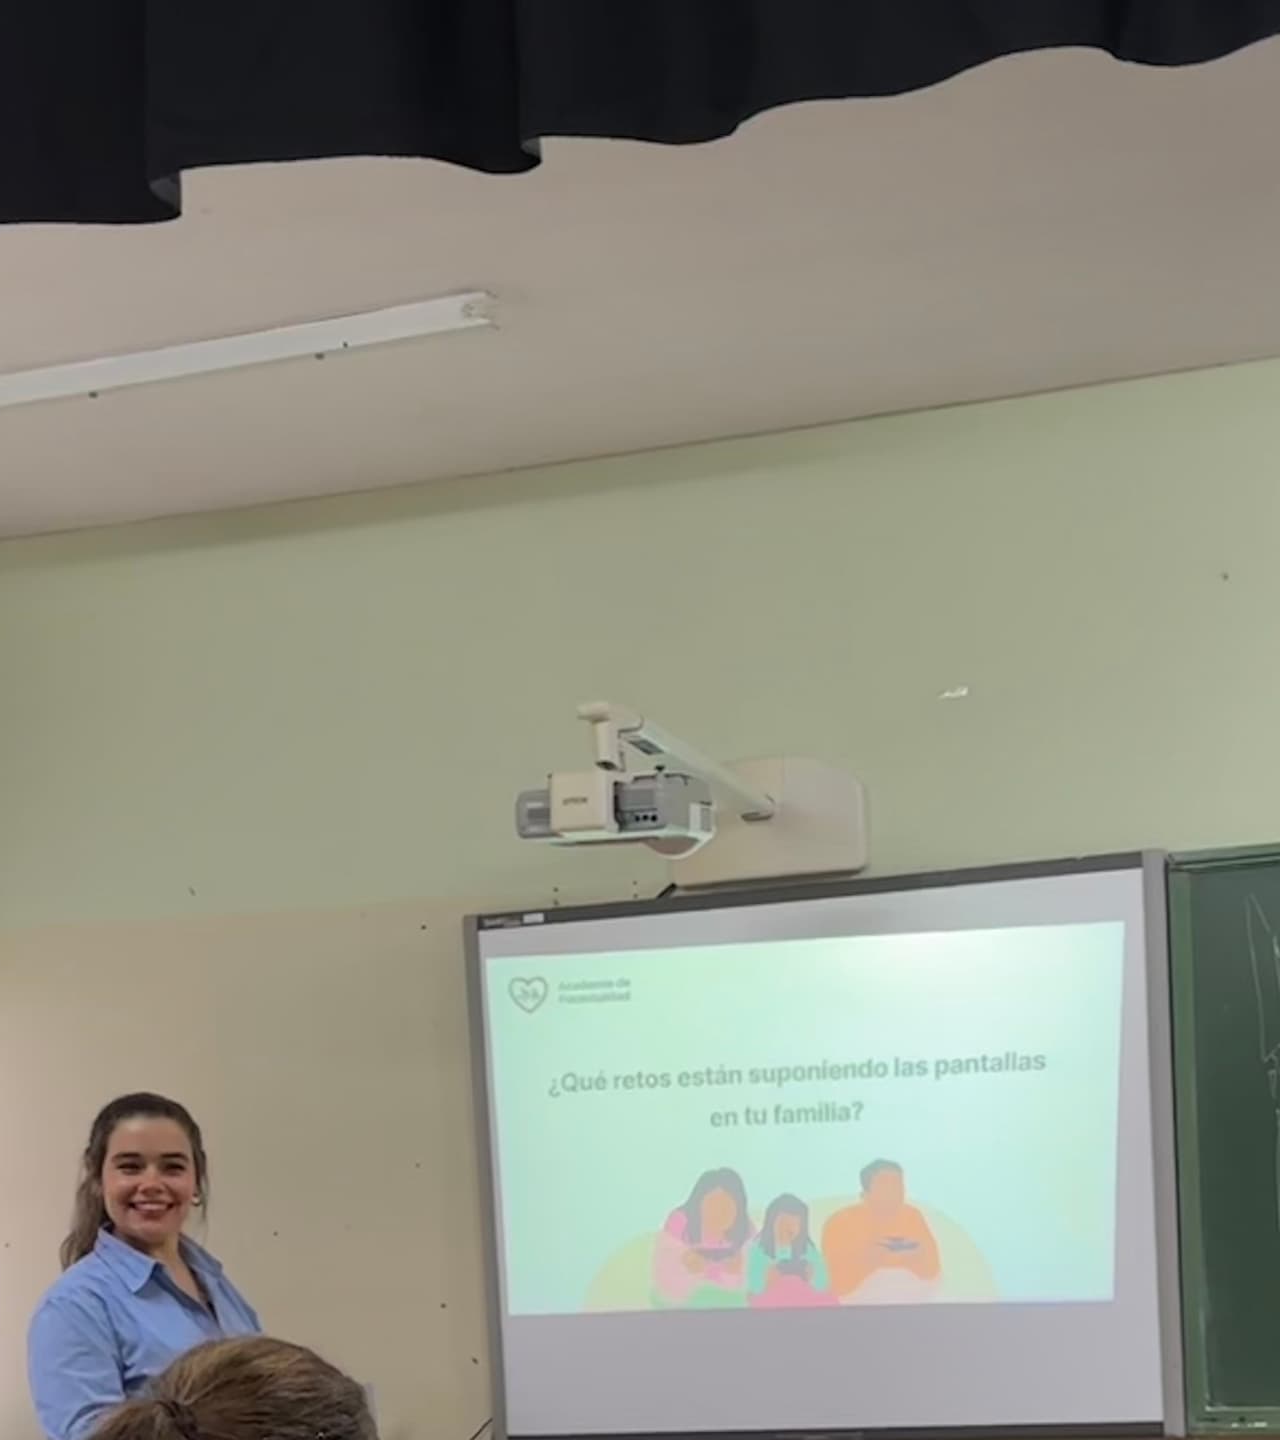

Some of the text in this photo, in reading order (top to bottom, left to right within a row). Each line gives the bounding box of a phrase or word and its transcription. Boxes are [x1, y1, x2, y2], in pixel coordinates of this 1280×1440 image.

[547, 1051, 1047, 1098] ¿Qué retos están suponiendo las pantallas
[709, 1101, 865, 1128] en tu familia?
